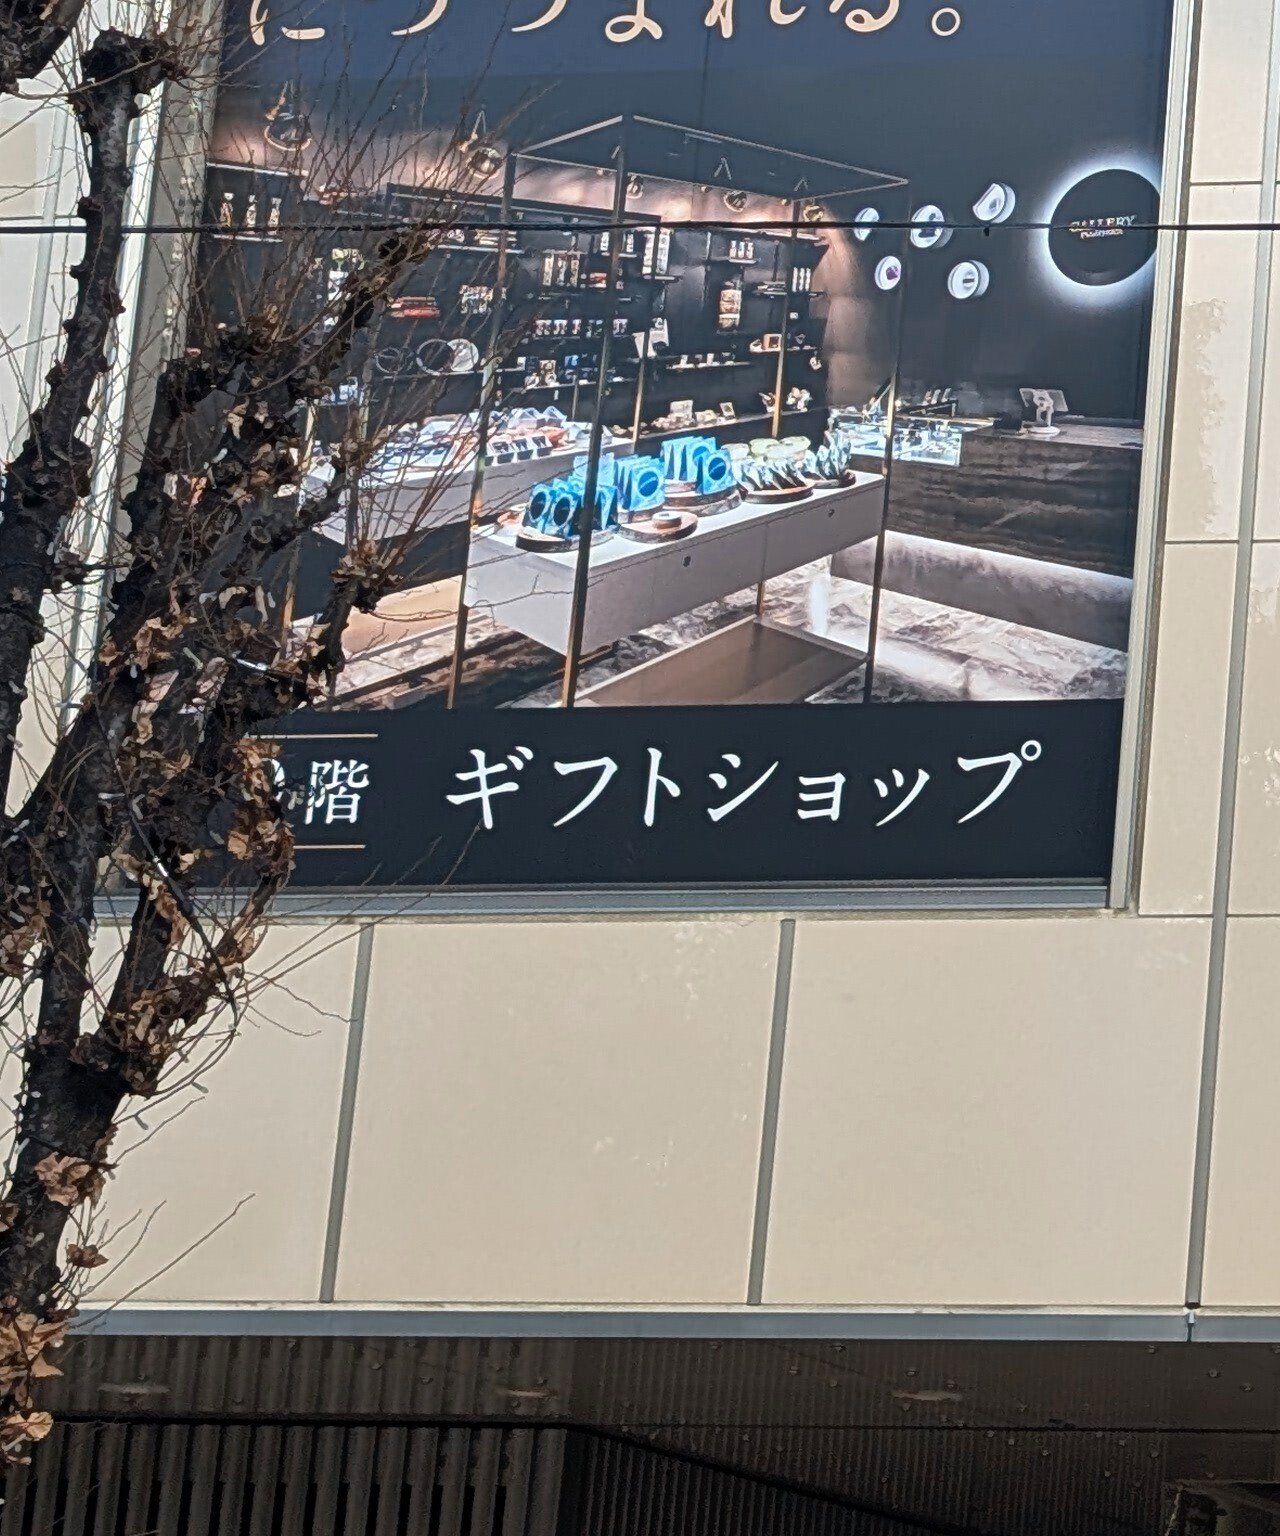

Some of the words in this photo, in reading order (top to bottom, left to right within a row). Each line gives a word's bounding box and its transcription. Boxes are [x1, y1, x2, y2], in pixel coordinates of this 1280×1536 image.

[446, 739, 1042, 830] ギフトショップ
